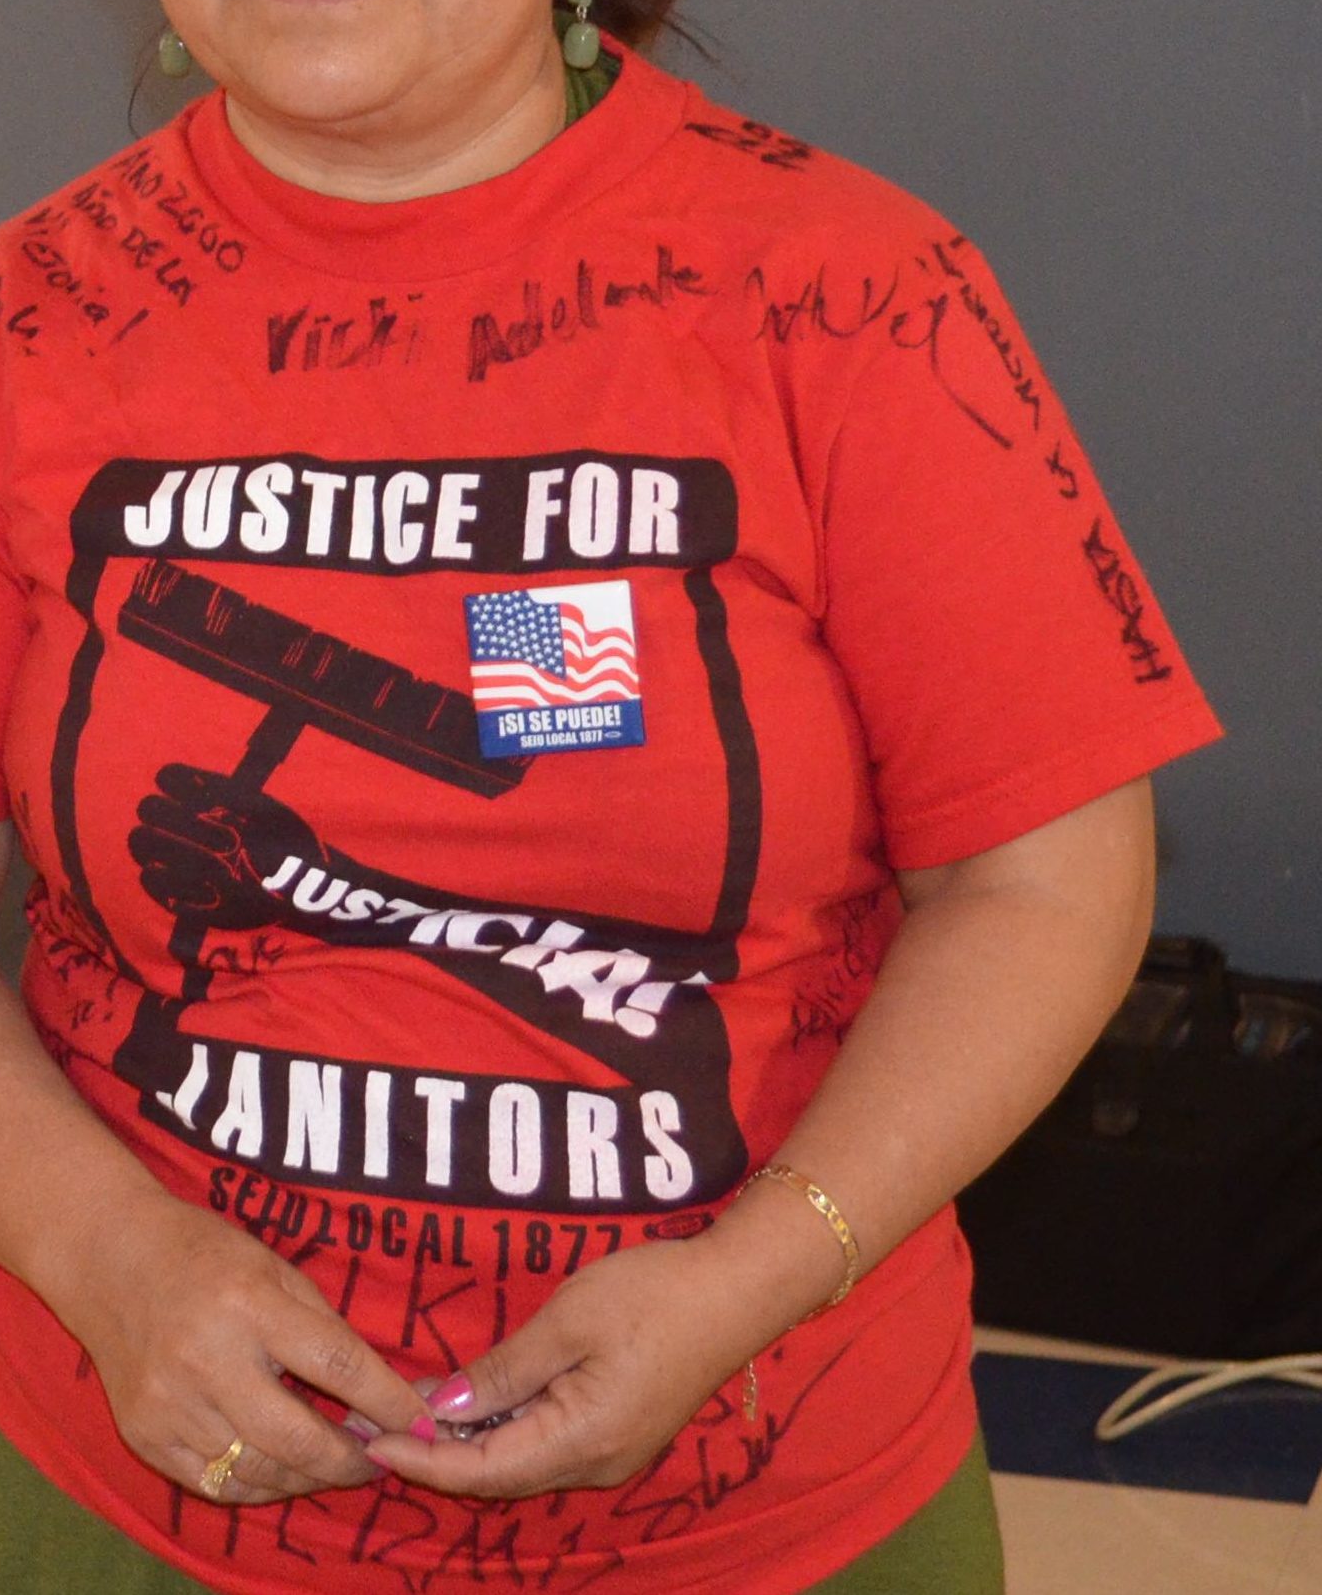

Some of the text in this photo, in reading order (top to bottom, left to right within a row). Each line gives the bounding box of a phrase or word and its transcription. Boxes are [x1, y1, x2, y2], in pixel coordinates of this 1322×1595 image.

[124, 462, 681, 565] JUSTICE FOR
[520, 729, 603, 748] SEIU LOCAL 1877
[529, 708, 553, 732] SE
[557, 704, 622, 730] PUEDE!
[262, 855, 712, 1038] JUSTICIA!
[155, 1042, 694, 1201] JANITORS
[311, 1205, 473, 1270] LOCAL
